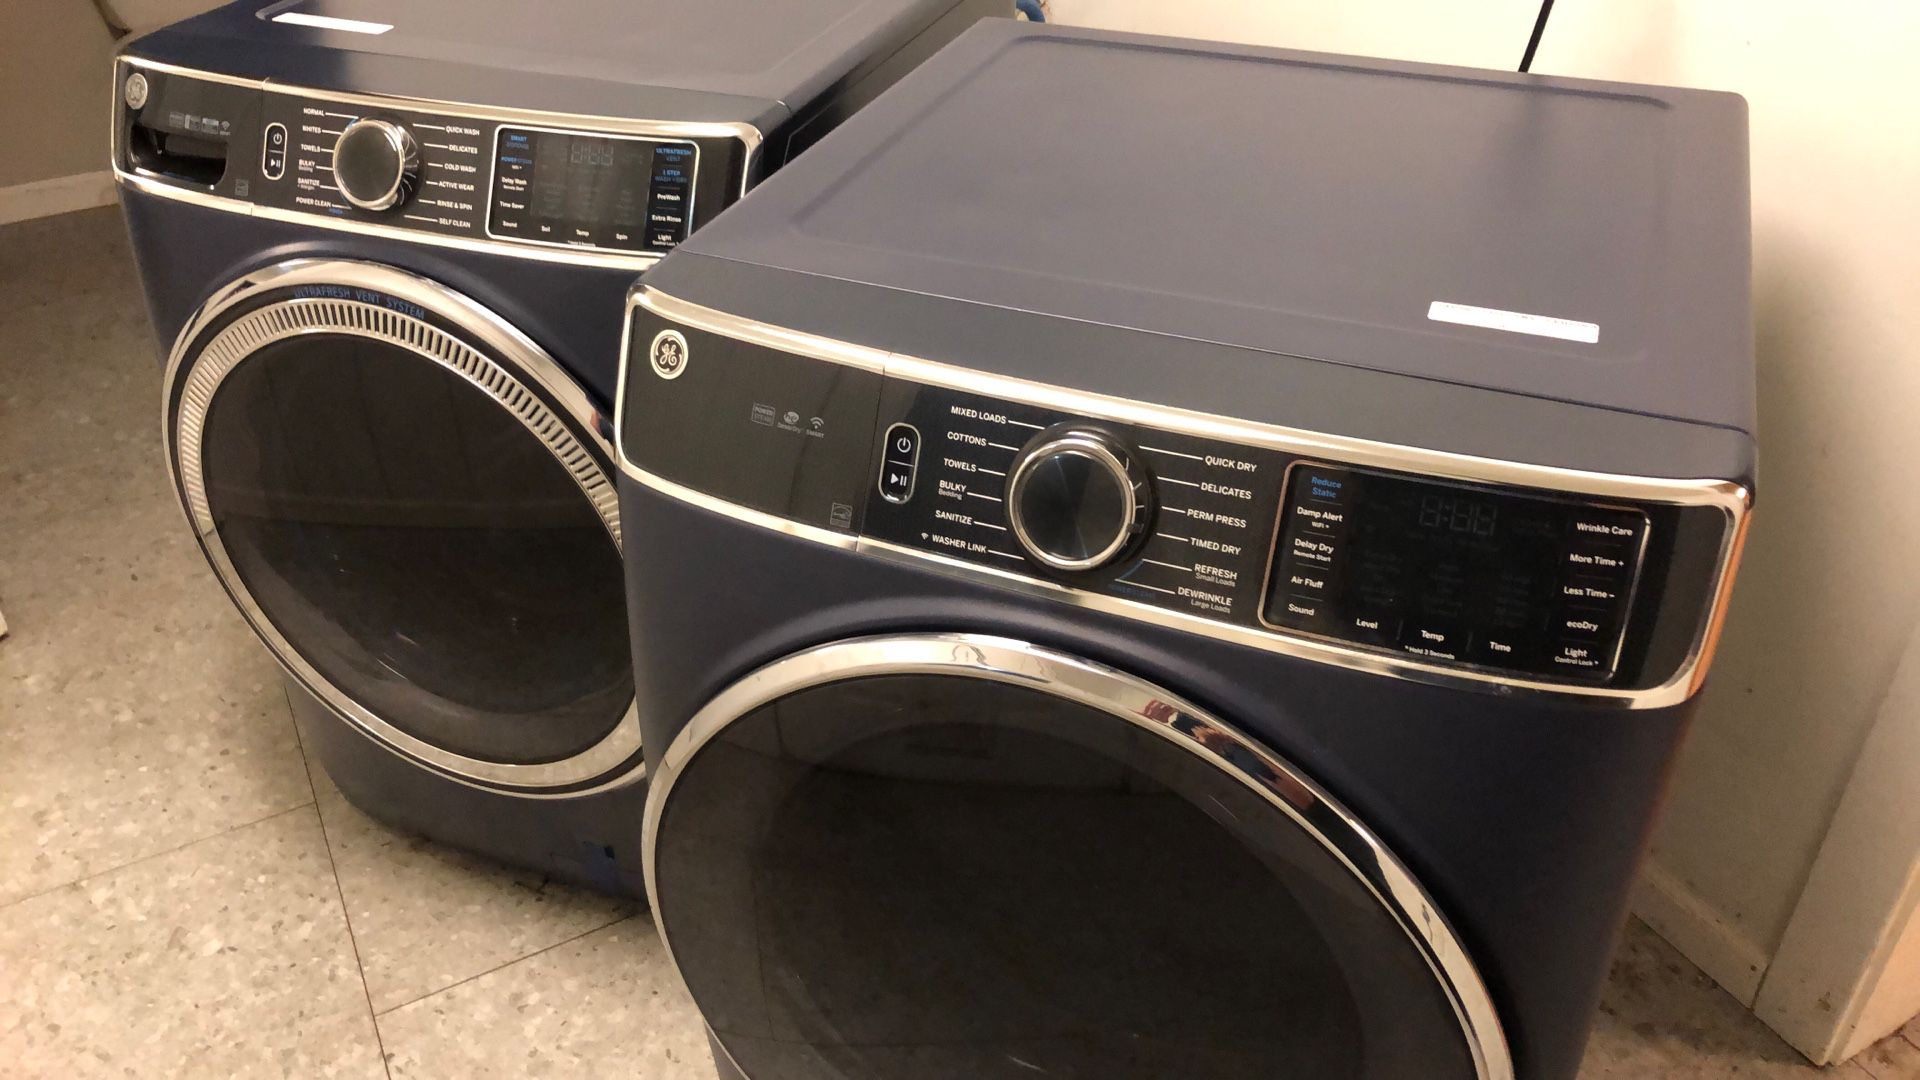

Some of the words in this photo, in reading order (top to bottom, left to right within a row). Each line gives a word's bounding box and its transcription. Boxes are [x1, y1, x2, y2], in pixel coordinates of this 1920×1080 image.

[303, 107, 325, 117] NORMAL
[446, 125, 463, 134] QUICK
[464, 127, 480, 136] WASH
[449, 144, 478, 154] DELICATES
[444, 162, 460, 171] COLD
[439, 180, 458, 190] ACTIVE
[458, 182, 475, 191] WEAR
[439, 217, 452, 226] SELF
[452, 219, 471, 228] CLEAN
[651, 214, 666, 222] Extra
[657, 234, 672, 242] Light
[294, 285, 351, 299] ULTRAFRESH
[355, 289, 380, 304] VENT
[385, 297, 425, 320] SYSTEM
[950, 406, 977, 418] MIXED
[978, 411, 1007, 425] LOADS
[947, 431, 987, 446] COTTONS
[943, 457, 977, 473] TOWELS
[1205, 455, 1236, 469] QUICK
[1236, 461, 1257, 473] DRY
[939, 479, 967, 493] BULKY
[1311, 476, 1342, 489] Reduce
[938, 487, 963, 501] Bedding
[1200, 482, 1252, 500] DELICATES
[1311, 486, 1337, 498] Static
[935, 509, 973, 526] SANITIZE
[1187, 508, 1214, 522] PERM
[1215, 514, 1247, 528] PRESS
[1296, 506, 1322, 519] Damp
[1321, 511, 1344, 523] Alert
[1576, 522, 1610, 534] Wrinkle
[1611, 525, 1633, 536] Care
[932, 534, 967, 549] WASHER
[967, 542, 987, 554] LINK
[1190, 537, 1220, 551] TIMED
[1221, 543, 1241, 556] DRY
[1294, 538, 1318, 551] Delay
[1318, 542, 1335, 555] Dry
[1293, 549, 1316, 560] Remote
[1315, 553, 1332, 563] Start
[1569, 553, 1593, 564] More
[1594, 556, 1616, 567] Time
[1194, 563, 1238, 580] REFRESH
[1195, 572, 1216, 583] Small
[1215, 577, 1236, 588] Loads
[1290, 575, 1304, 585] Air
[1304, 577, 1324, 589] Fluff
[1178, 586, 1233, 607] DEWRINKLE
[1563, 585, 1584, 596] Less
[1585, 588, 1608, 599] Time
[1190, 598, 1210, 610] Large
[1210, 603, 1231, 615] Loads
[1287, 603, 1315, 617] Sound
[1355, 618, 1379, 630] Level
[1566, 620, 1599, 633] ecoDry
[1420, 629, 1445, 643] Temp
[1489, 641, 1512, 653] Time
[1564, 646, 1588, 658] Light
[1554, 655, 1578, 665] Control
[1578, 658, 1594, 667] Lock
